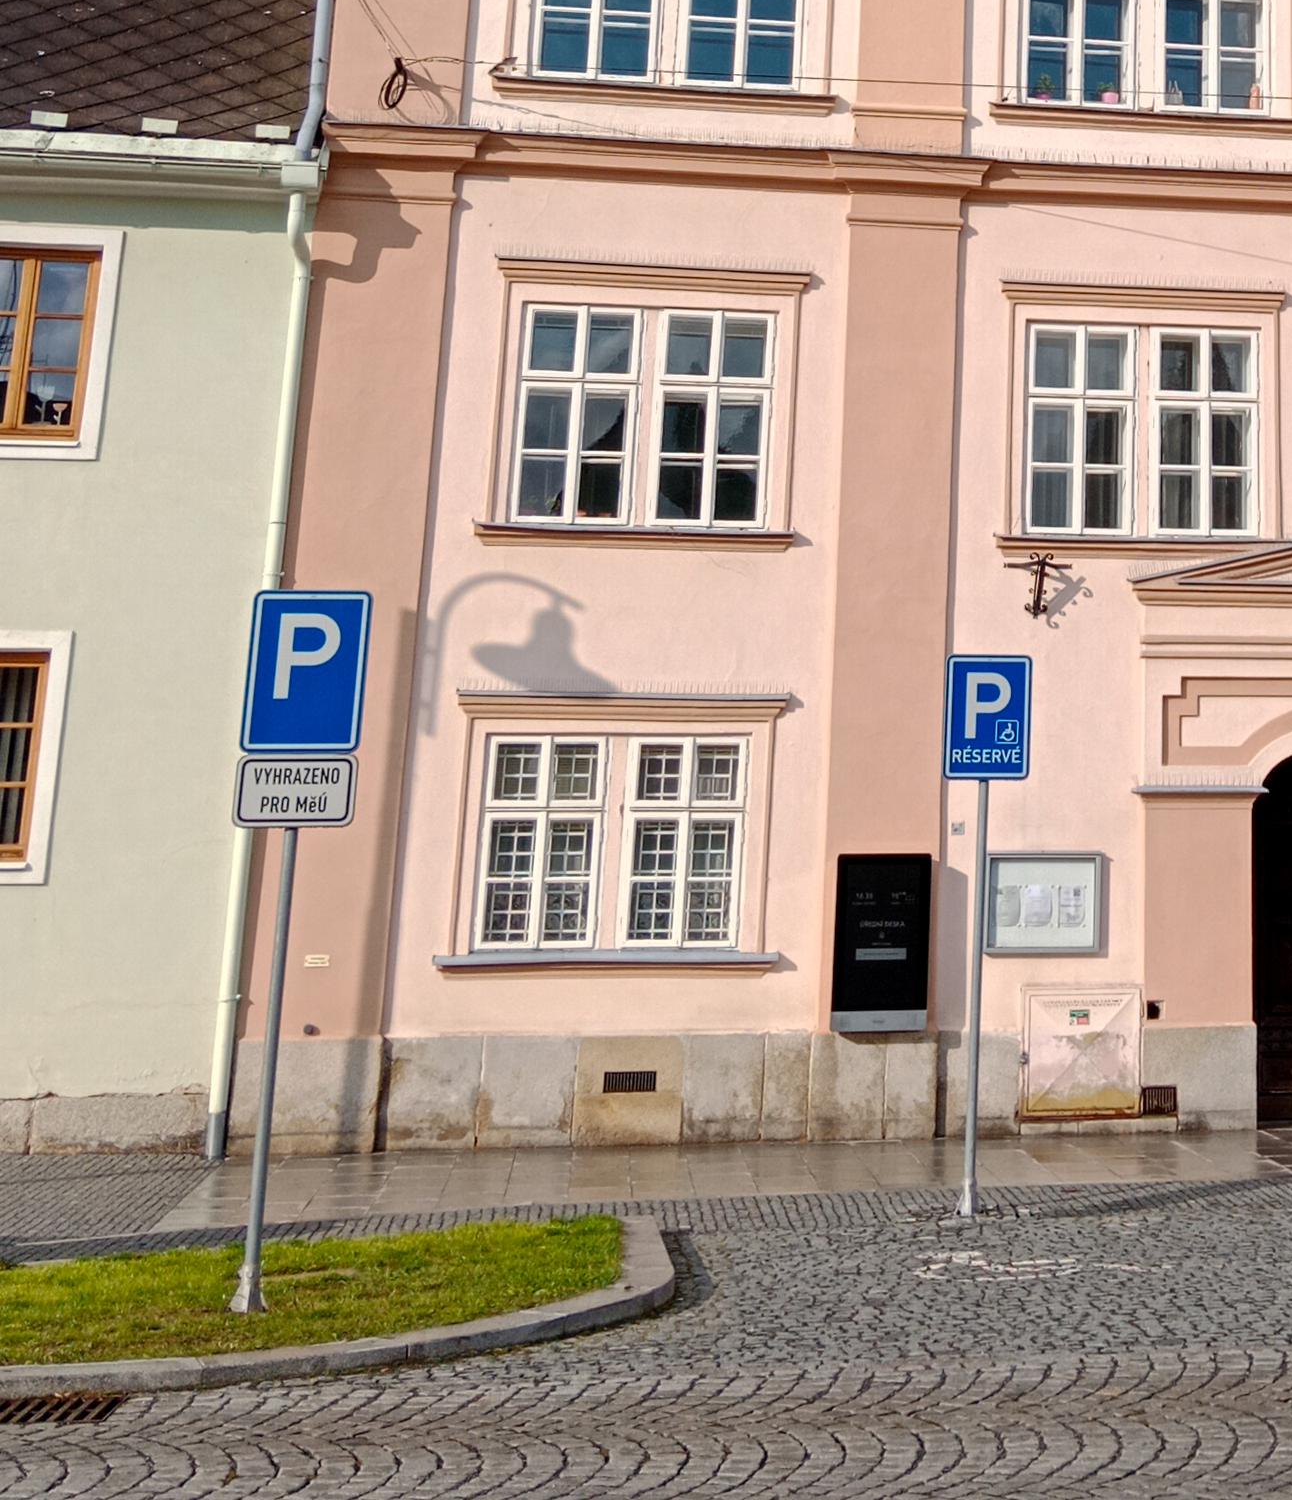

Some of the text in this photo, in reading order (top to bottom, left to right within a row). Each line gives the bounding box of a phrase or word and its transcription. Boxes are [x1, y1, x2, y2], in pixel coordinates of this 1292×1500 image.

[273, 613, 341, 700] P
[964, 672, 1012, 739] P
[952, 745, 1022, 763] RÉSERVÉ
[254, 767, 341, 785] VYHRAZENO
[260, 792, 328, 813] PRO MěÚ
